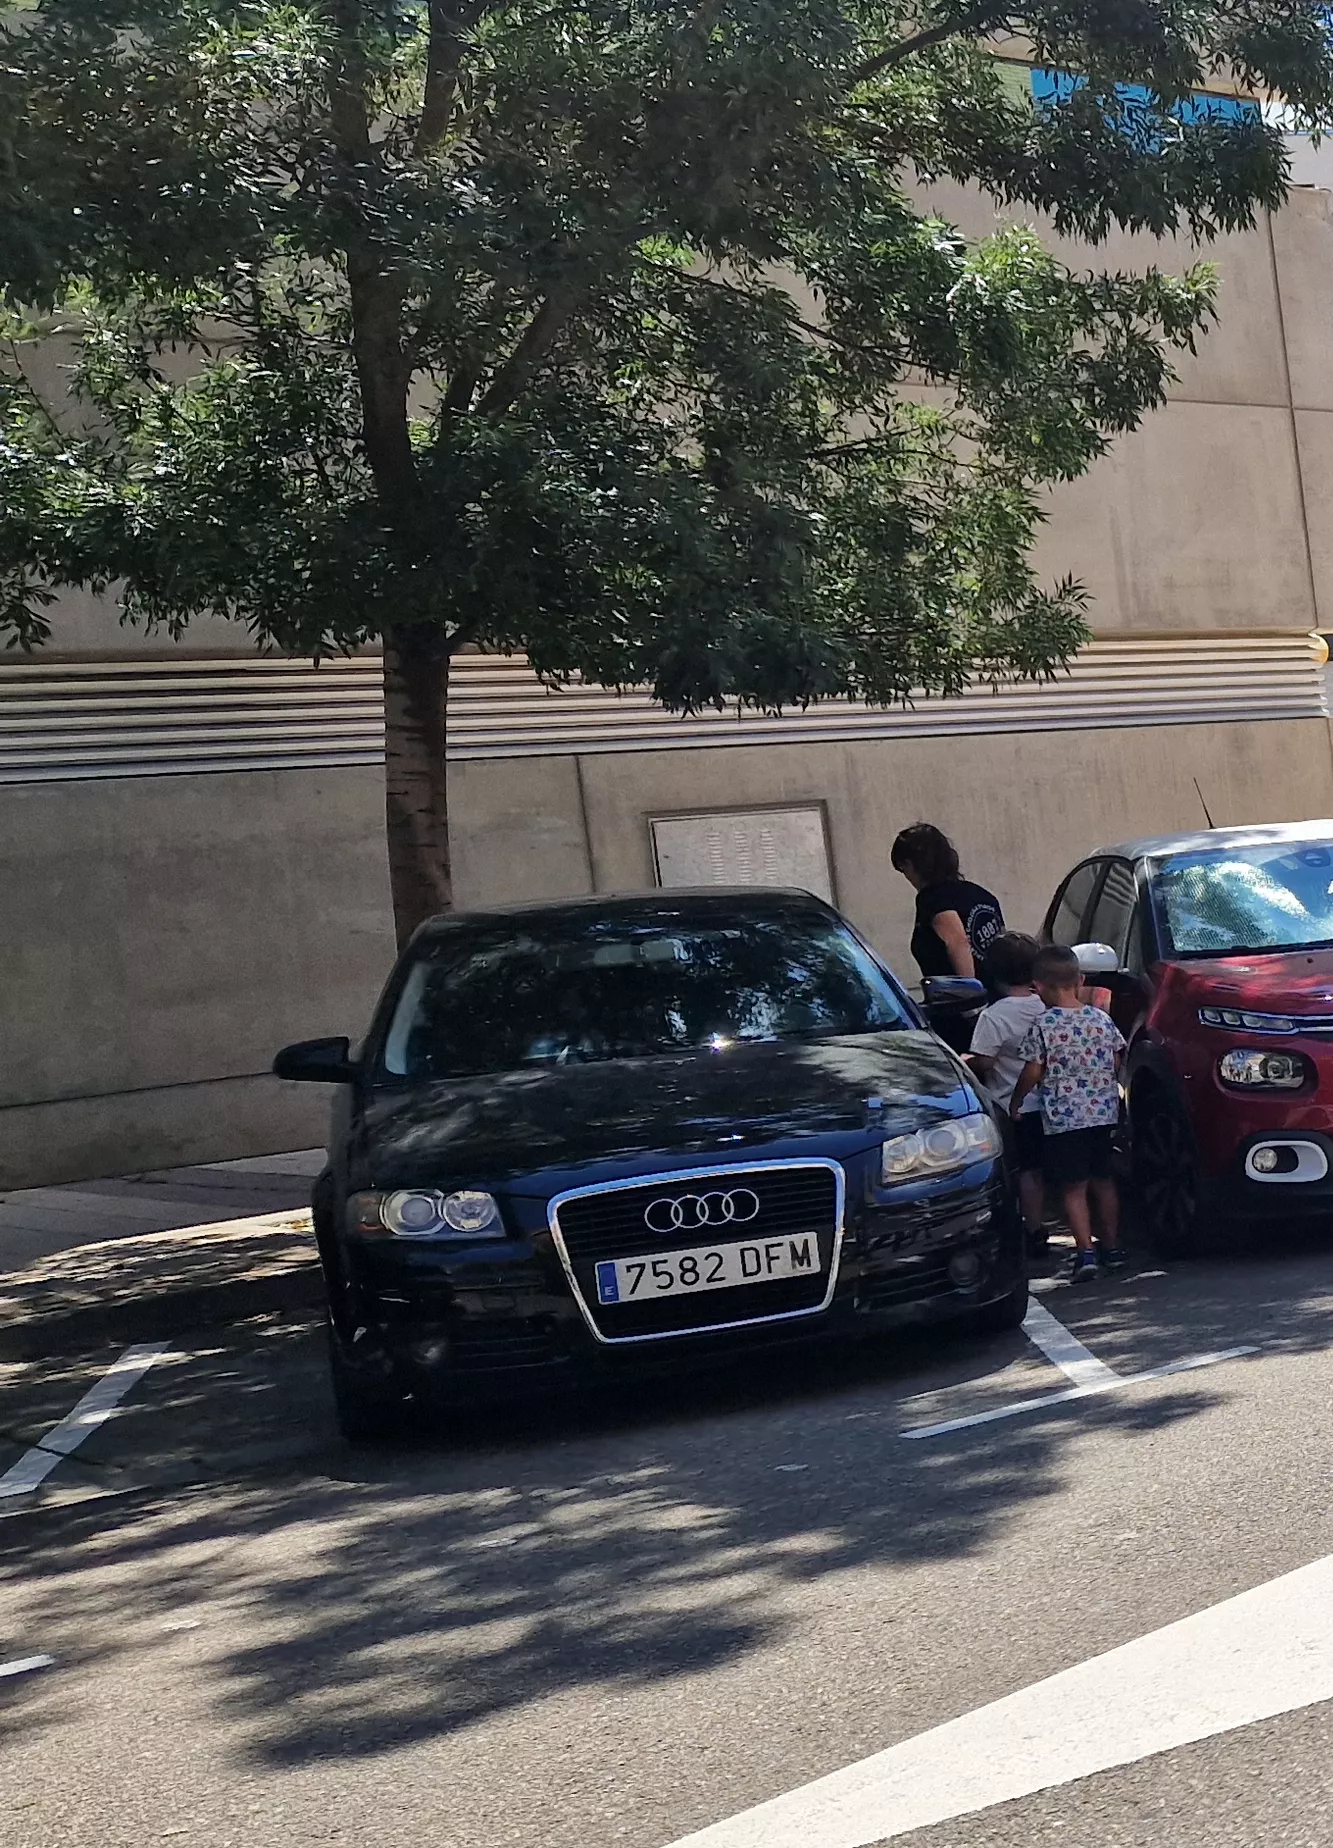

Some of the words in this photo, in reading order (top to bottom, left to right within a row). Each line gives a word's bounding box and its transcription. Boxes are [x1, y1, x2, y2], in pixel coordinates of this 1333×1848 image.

[625, 1252, 726, 1295] 7582
[739, 1238, 812, 1278] DFM
[604, 1286, 614, 1296] E
